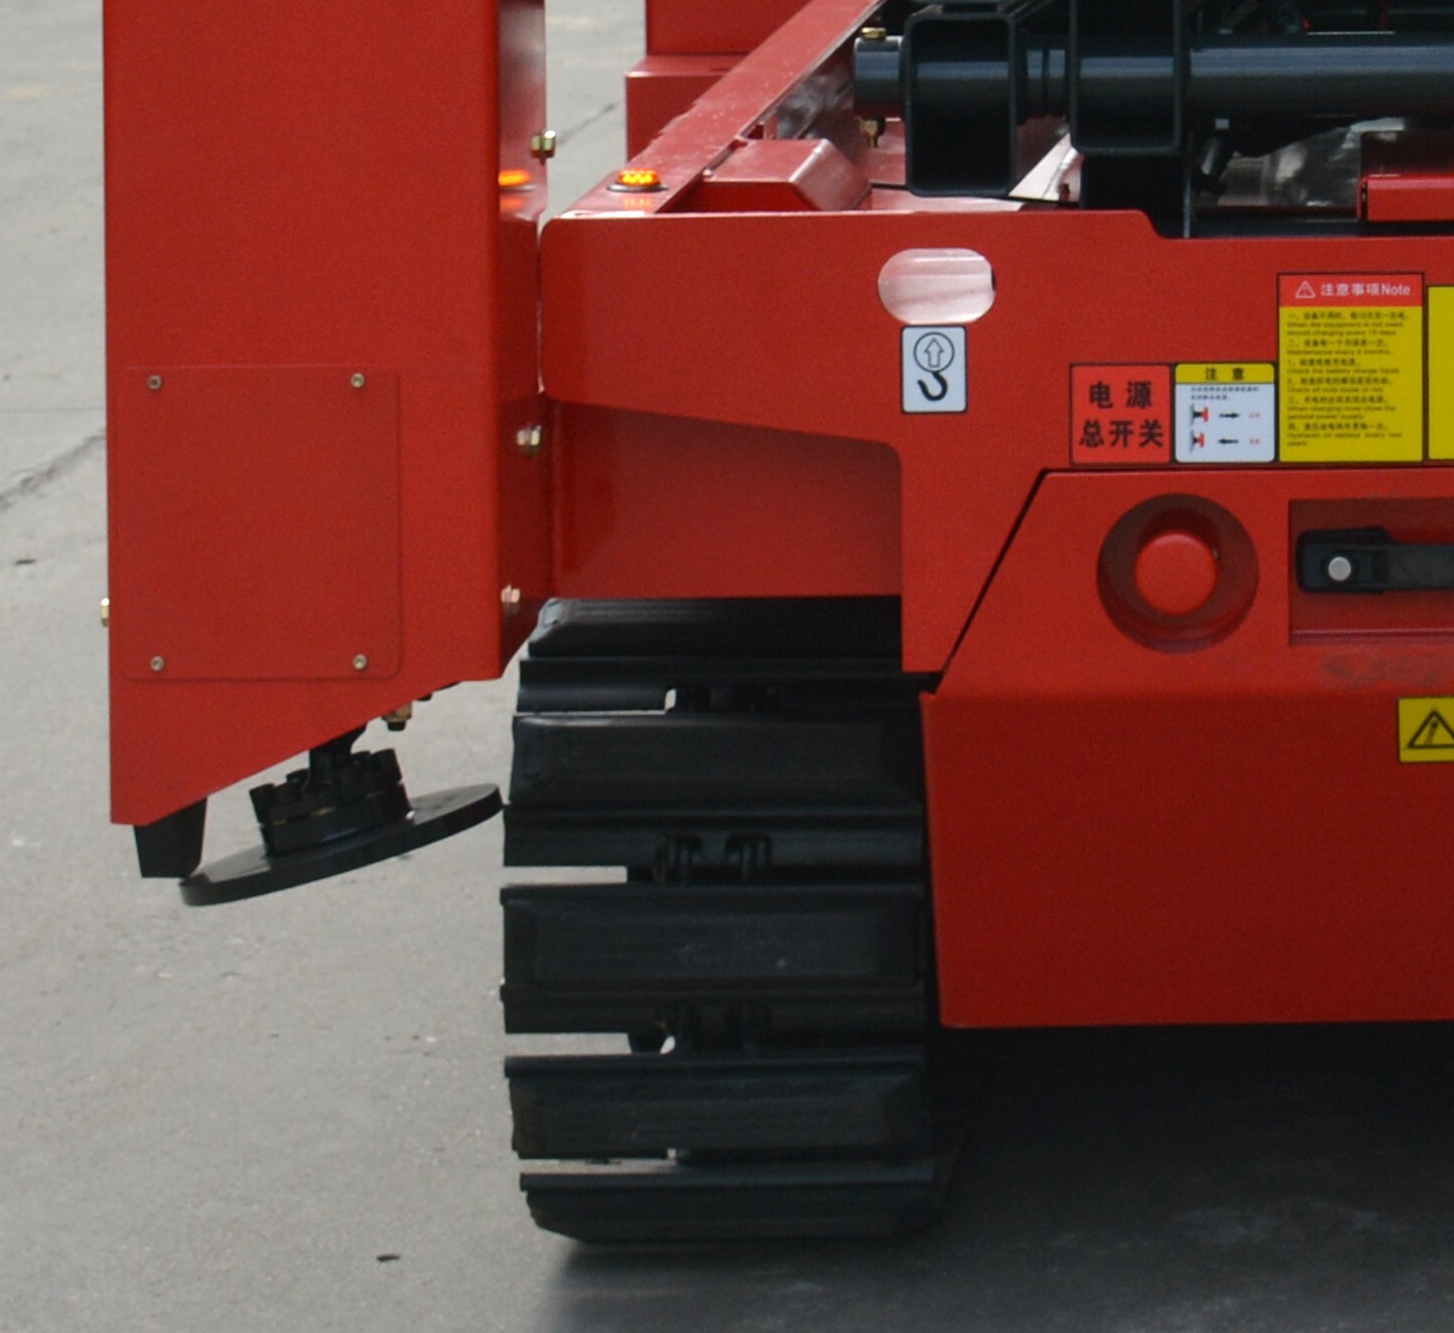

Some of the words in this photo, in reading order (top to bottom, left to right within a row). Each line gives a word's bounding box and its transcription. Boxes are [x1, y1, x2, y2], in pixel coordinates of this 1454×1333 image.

[1088, 380, 1153, 409] 电源
[1078, 418, 1165, 448] 总开关
